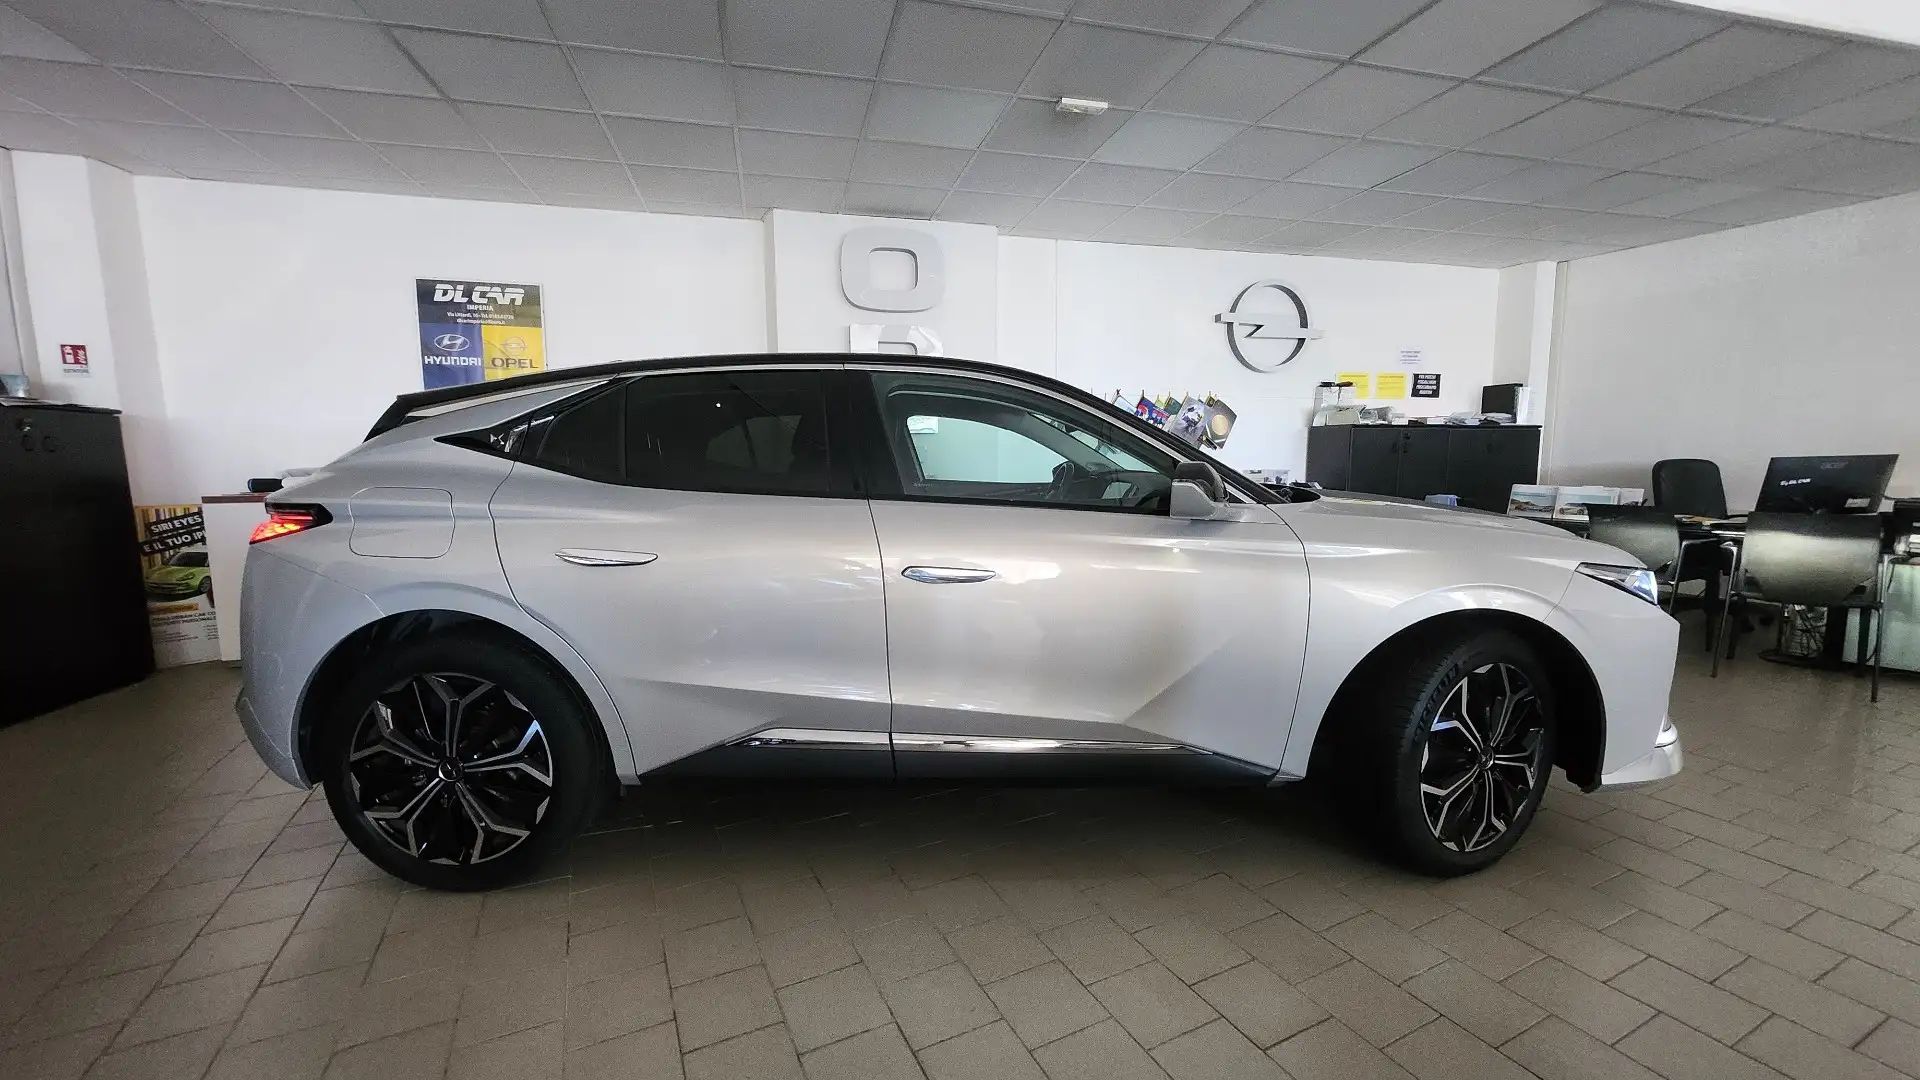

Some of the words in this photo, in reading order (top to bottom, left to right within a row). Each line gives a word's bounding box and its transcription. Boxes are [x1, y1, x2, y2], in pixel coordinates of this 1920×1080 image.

[433, 283, 469, 303] DL
[472, 286, 525, 306] CAR
[466, 304, 494, 312] IMPERIA
[424, 355, 482, 366] HYUNDAI
[491, 357, 539, 369] OPEL
[150, 521, 173, 533] SIRI
[173, 515, 202, 528] EYES
[152, 541, 165, 550] IL
[165, 534, 192, 547] TUO
